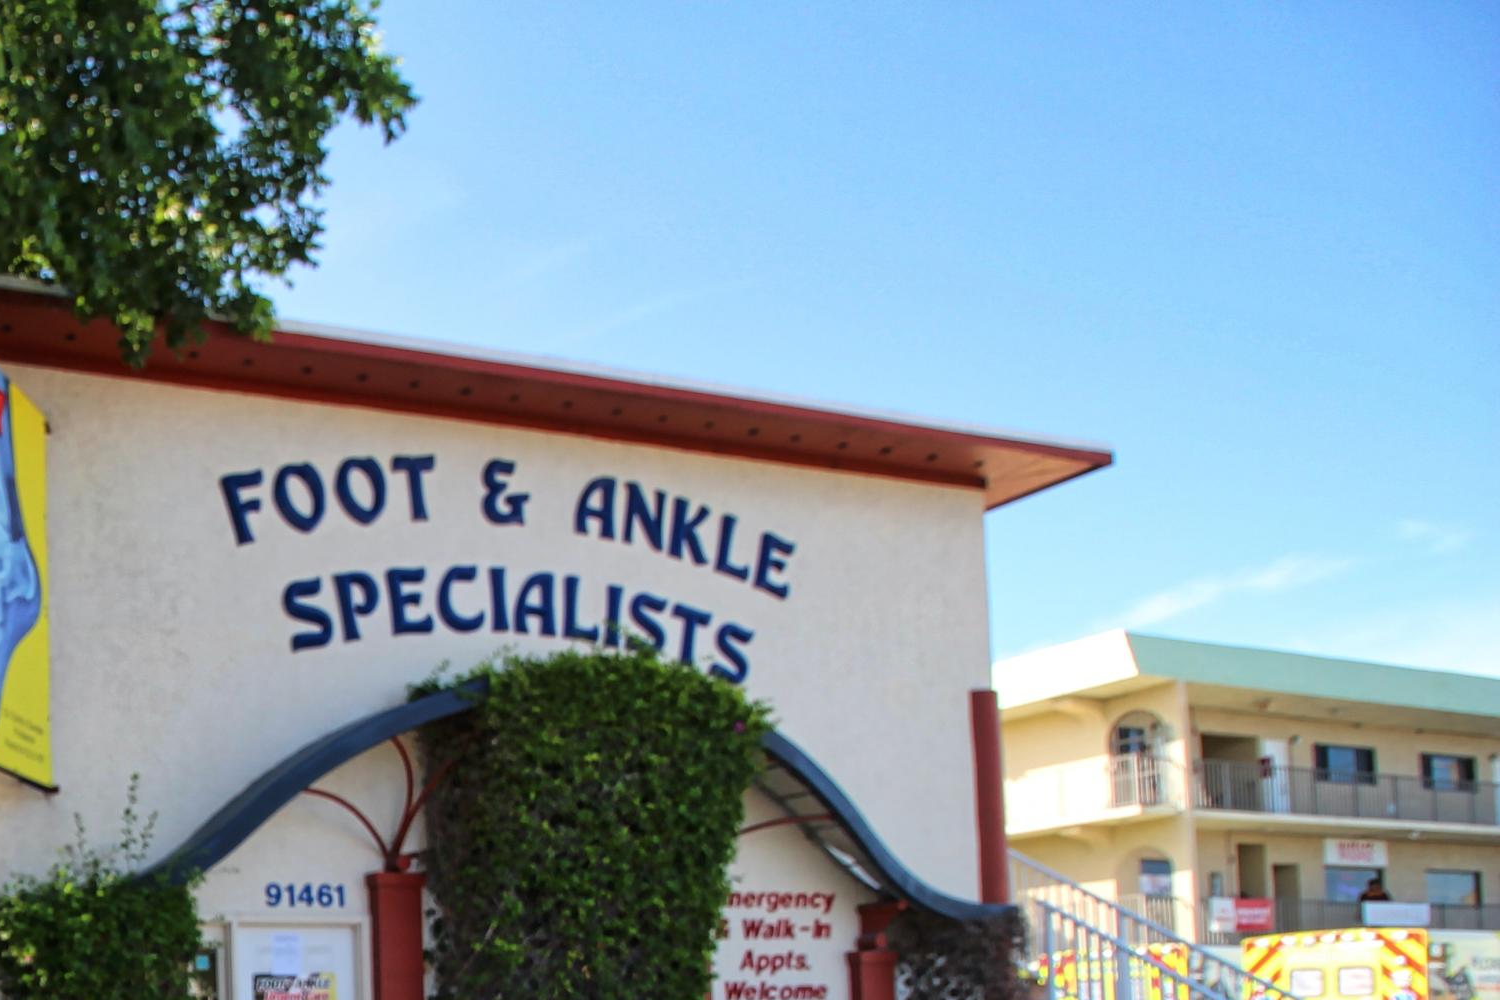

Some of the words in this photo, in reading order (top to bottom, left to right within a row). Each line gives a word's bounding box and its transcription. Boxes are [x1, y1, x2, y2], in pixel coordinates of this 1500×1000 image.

[220, 454, 436, 546] FOOT
[481, 458, 530, 526] &
[574, 475, 796, 600] ANKLE
[281, 565, 754, 685] SPECIALISTS
[265, 882, 346, 908] 91461
[727, 891, 835, 913] mergency
[740, 950, 810, 975] Appts.
